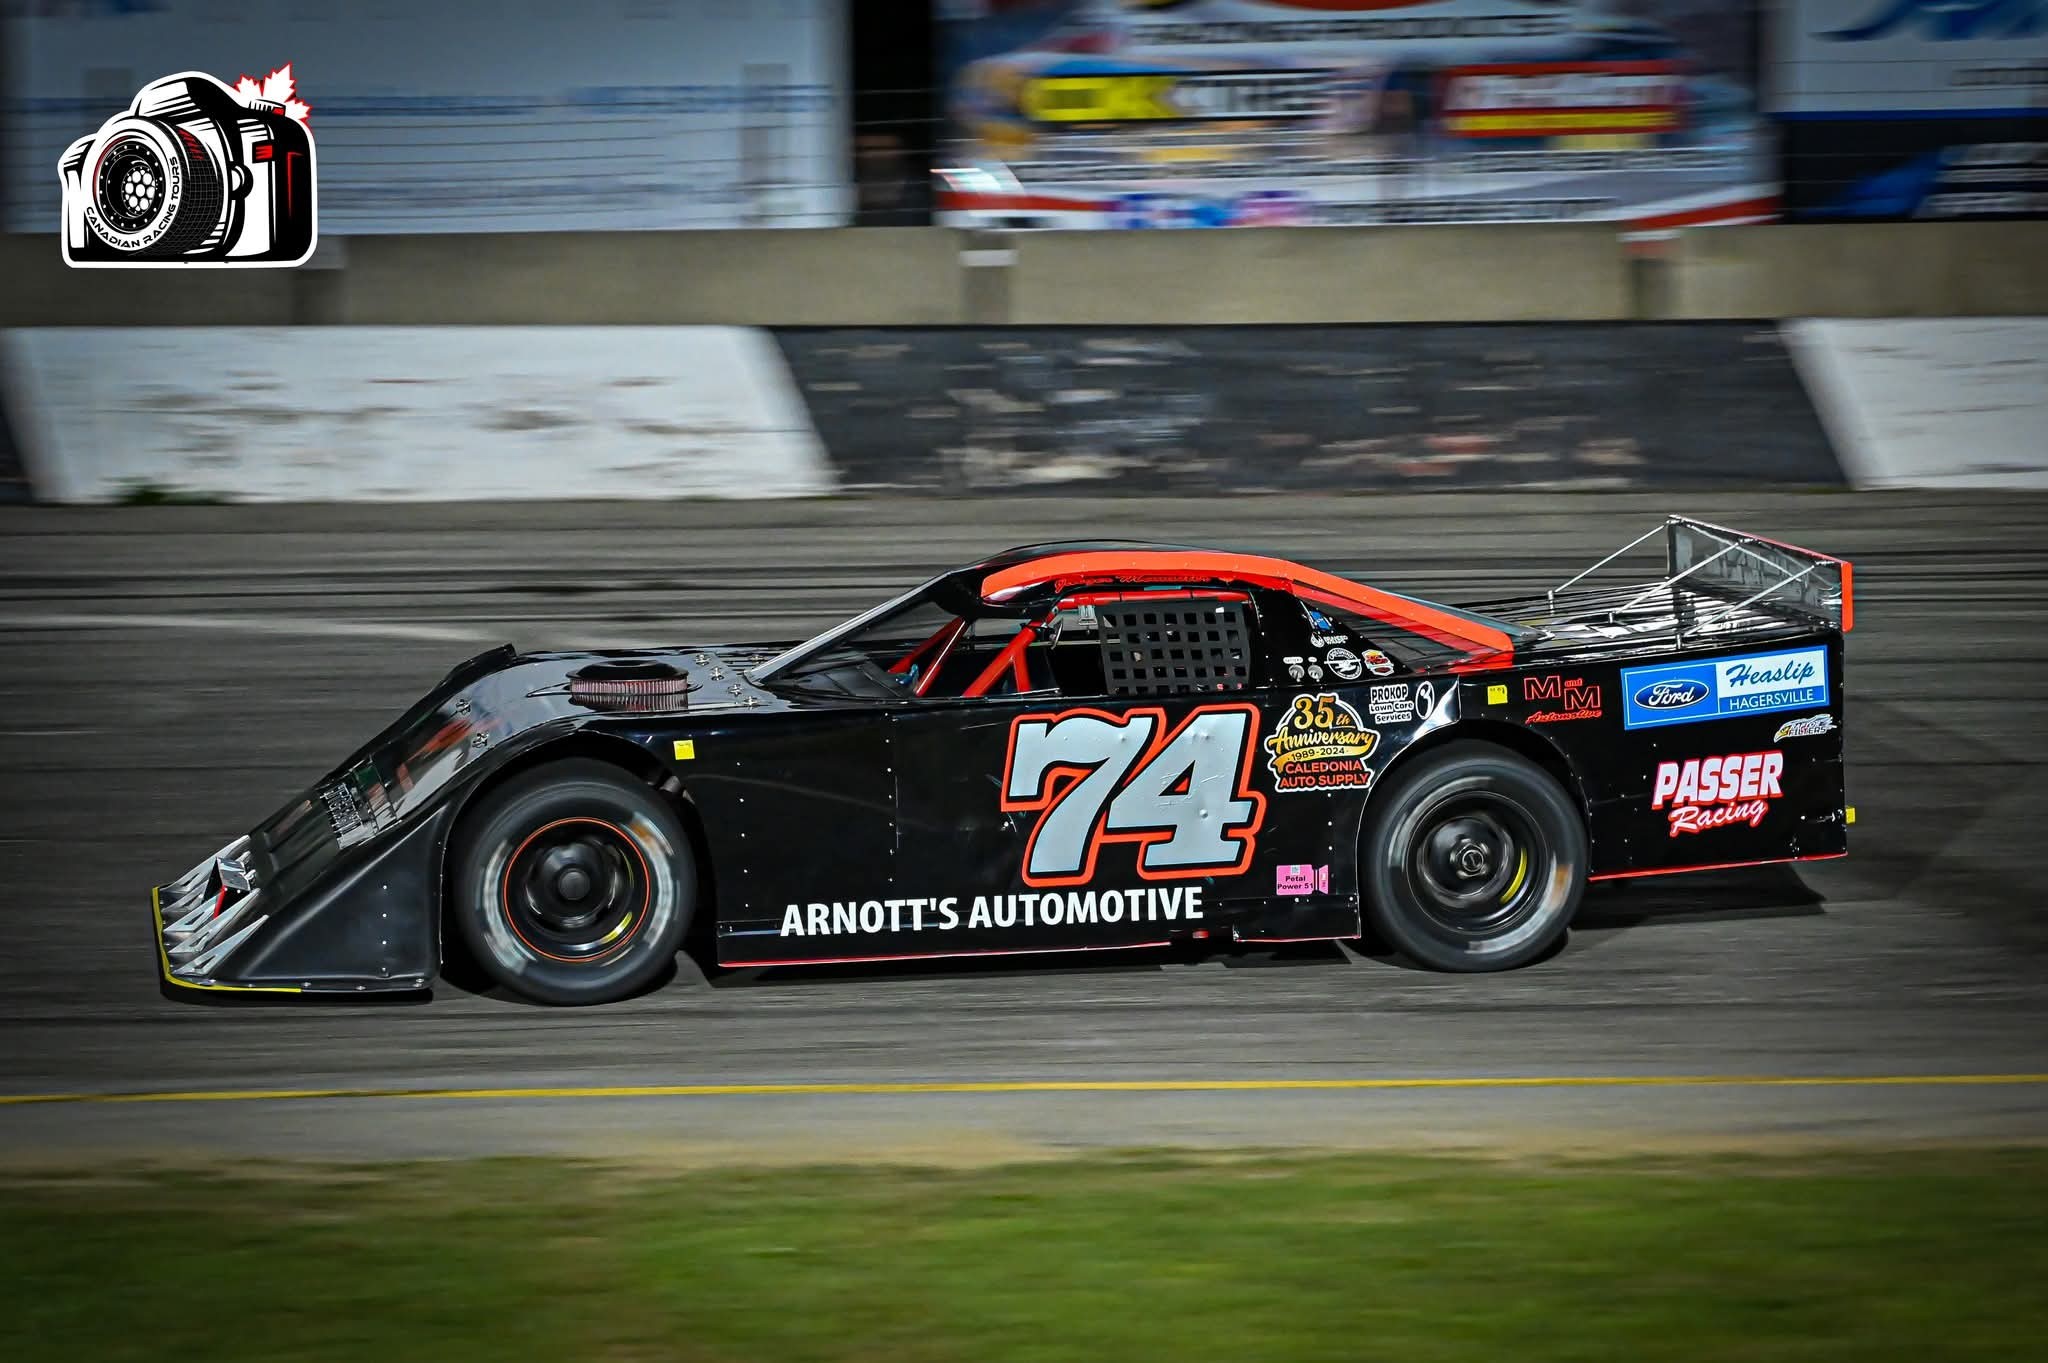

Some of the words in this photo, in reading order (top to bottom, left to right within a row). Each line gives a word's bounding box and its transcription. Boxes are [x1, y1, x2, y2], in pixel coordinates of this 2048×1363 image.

[1726, 660, 1815, 688] Heaslip
[1371, 686, 1408, 702] PROKOP
[1524, 676, 1561, 701] M
[1564, 686, 1601, 711] M
[1648, 684, 1695, 706] Ford
[1729, 688, 1814, 711] HAGERSVILLE
[1294, 695, 1337, 730] 35
[1336, 714, 1351, 726] th
[1370, 703, 1392, 712] Lawn
[1394, 701, 1414, 711] Care
[1376, 712, 1411, 722] Services
[1525, 709, 1602, 725] Automotive
[1267, 726, 1376, 755] Anniversary
[1291, 746, 1346, 761] 1989-2024
[1285, 760, 1363, 774] CALEDONIA
[1280, 775, 1315, 788] AUTO
[1318, 773, 1369, 787] SUPPLY
[1653, 752, 1783, 808] PASSER
[1001, 703, 1267, 888] 74
[1669, 800, 1768, 837] Racing
[779, 896, 960, 938] ARNOTT'S
[967, 885, 1205, 930] AUTOMOTIVE
